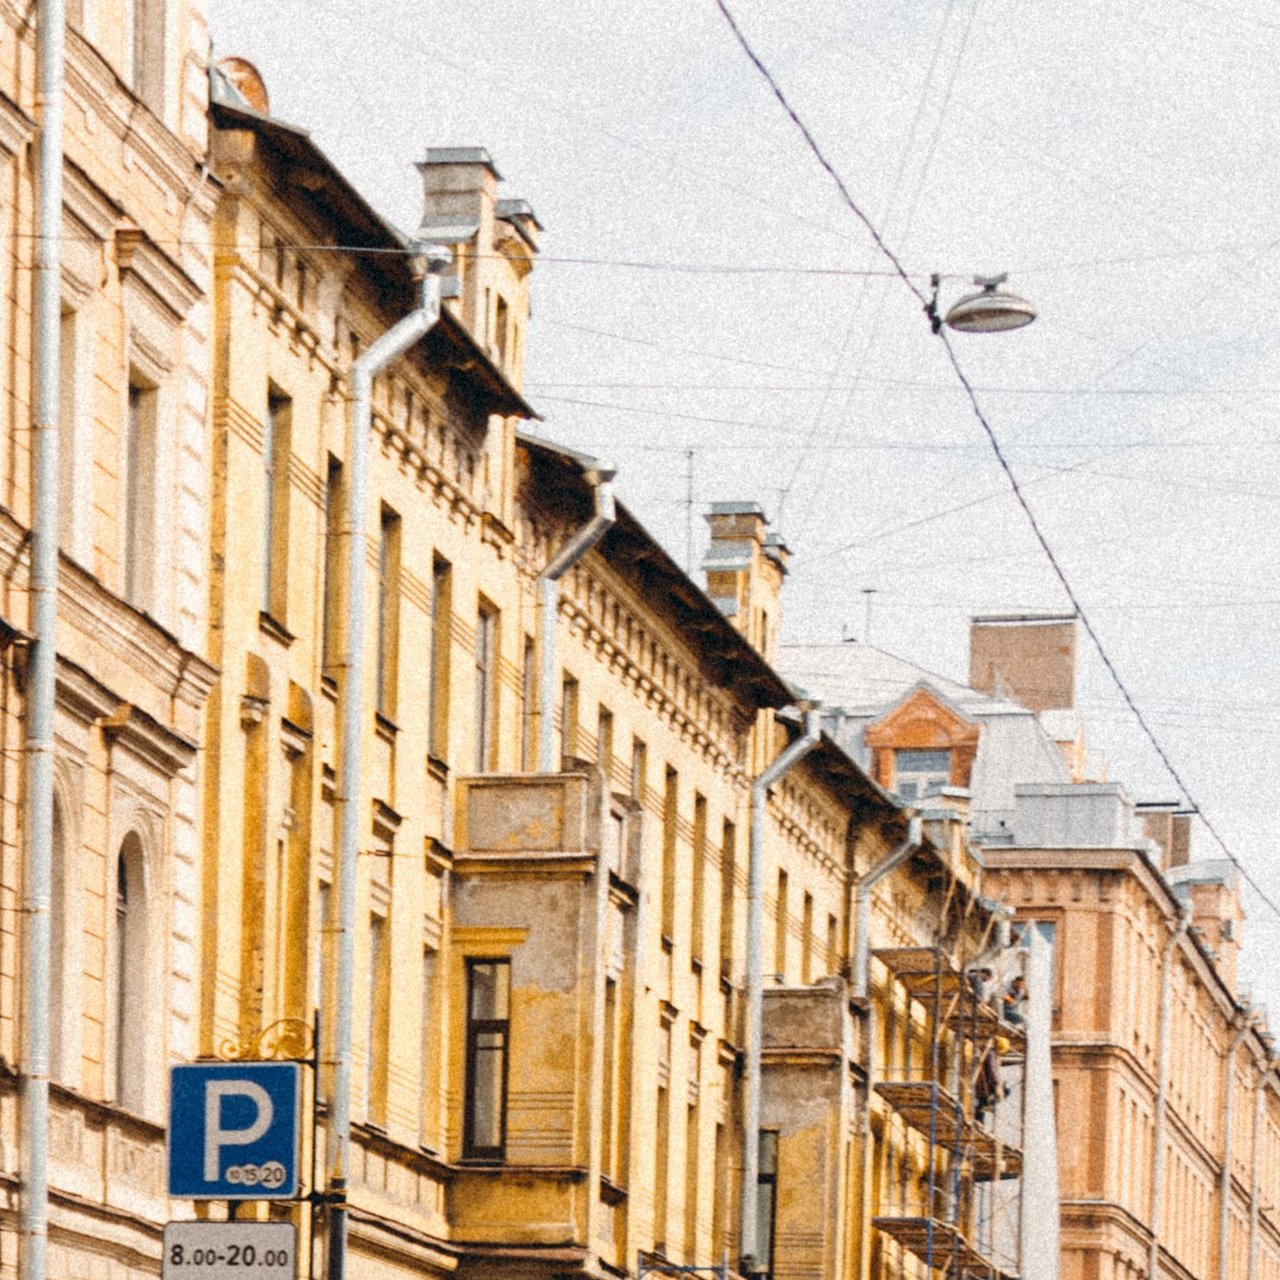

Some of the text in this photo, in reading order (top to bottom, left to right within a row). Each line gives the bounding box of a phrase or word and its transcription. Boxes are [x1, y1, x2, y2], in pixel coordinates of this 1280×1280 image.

[204, 1080, 274, 1182] P
[244, 1168, 258, 1182] 15
[263, 1167, 284, 1183] 20
[170, 1244, 289, 1268] 8.00-20.00
